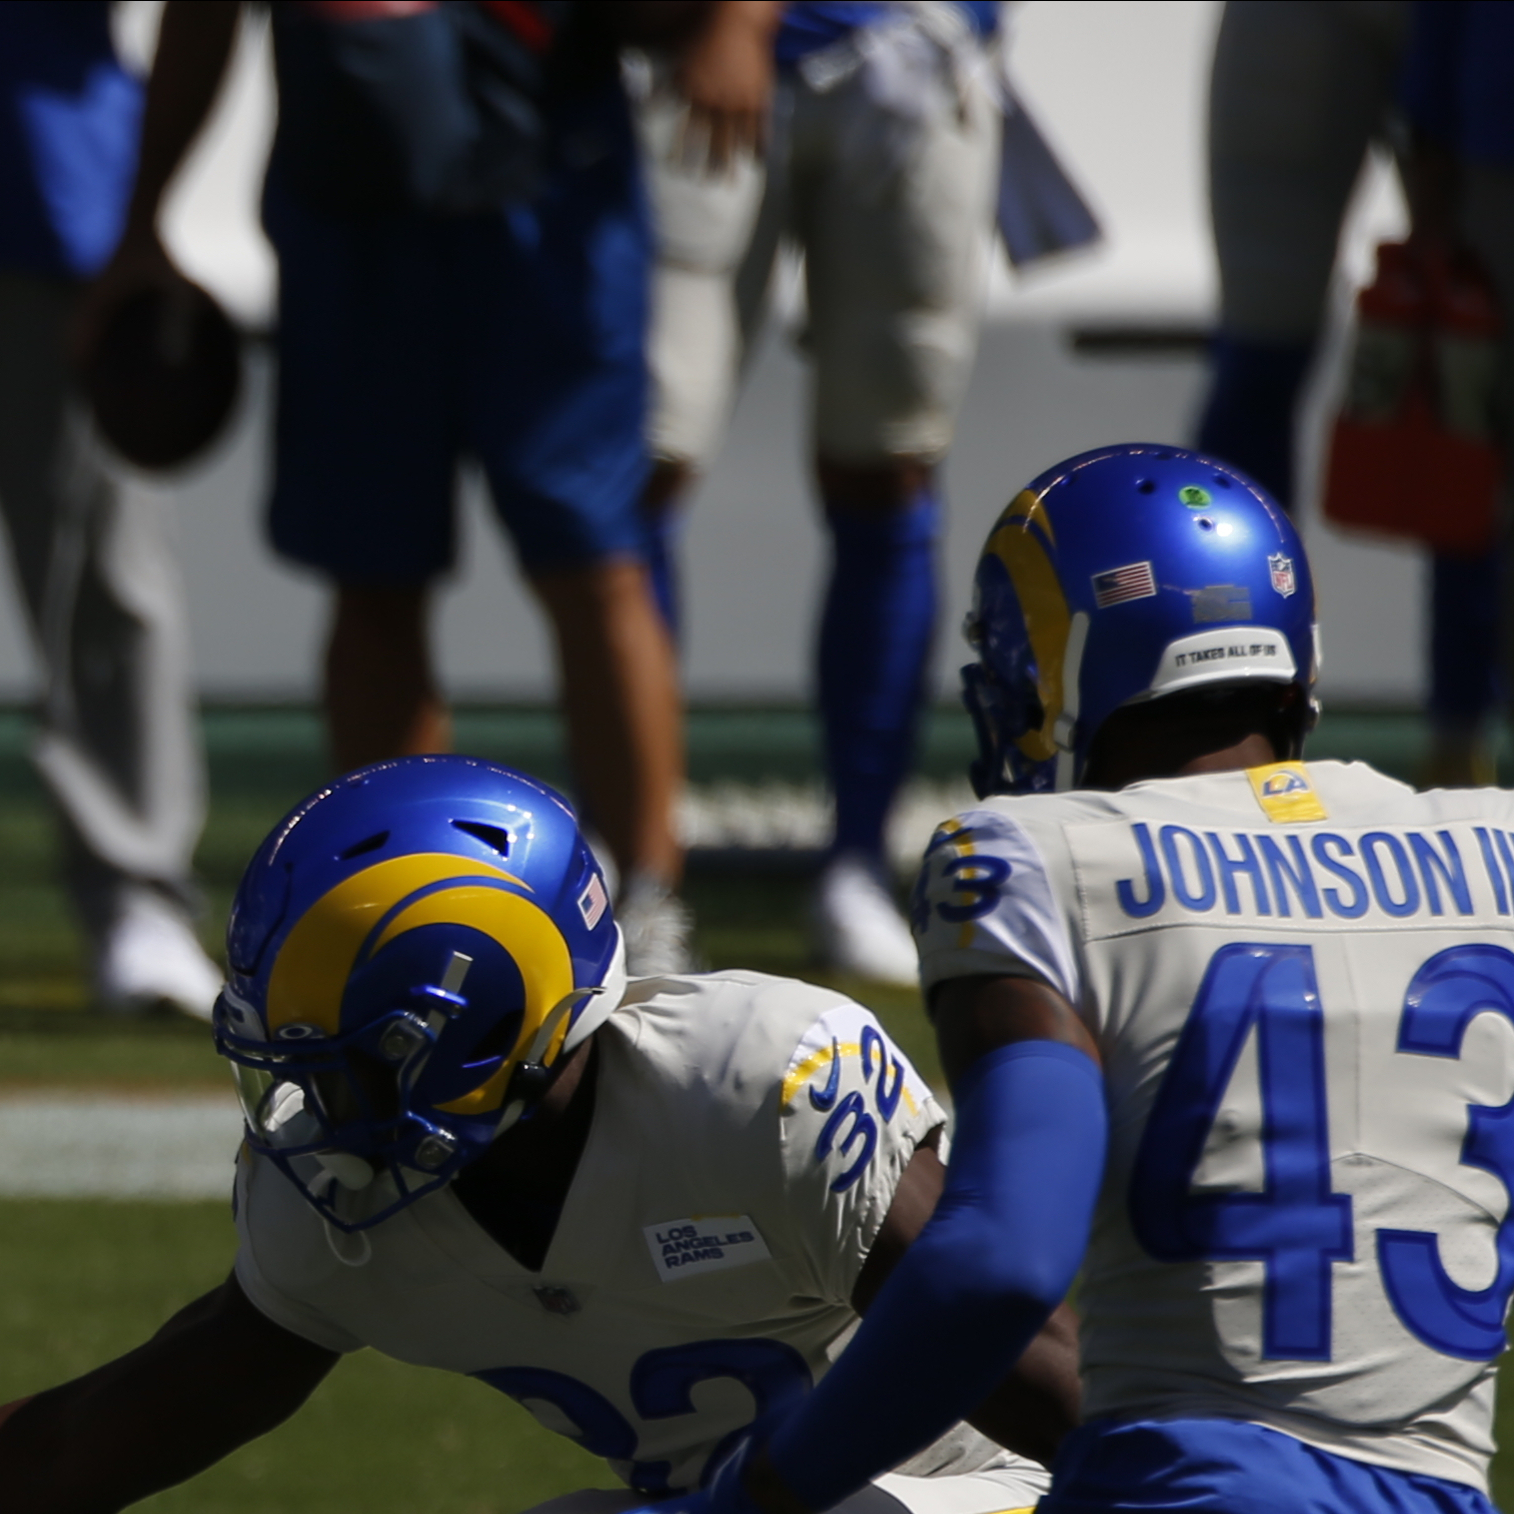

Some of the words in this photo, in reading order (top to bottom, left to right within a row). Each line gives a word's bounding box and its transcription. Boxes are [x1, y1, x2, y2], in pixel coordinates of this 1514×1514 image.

[1175, 654, 1186, 667] IT
[1189, 647, 1225, 664] TAKES
[1227, 645, 1248, 657] ALL
[1249, 644, 1263, 657] OF
[1263, 644, 1276, 657] US
[1115, 822, 1475, 920] JOHNSON
[1471, 826, 1514, 916] II
[815, 1024, 904, 1193] 32
[1127, 942, 1514, 1362] 43
[655, 1225, 698, 1244] LOS
[662, 1231, 755, 1257] ANGELES
[664, 1247, 725, 1269] RAMS
